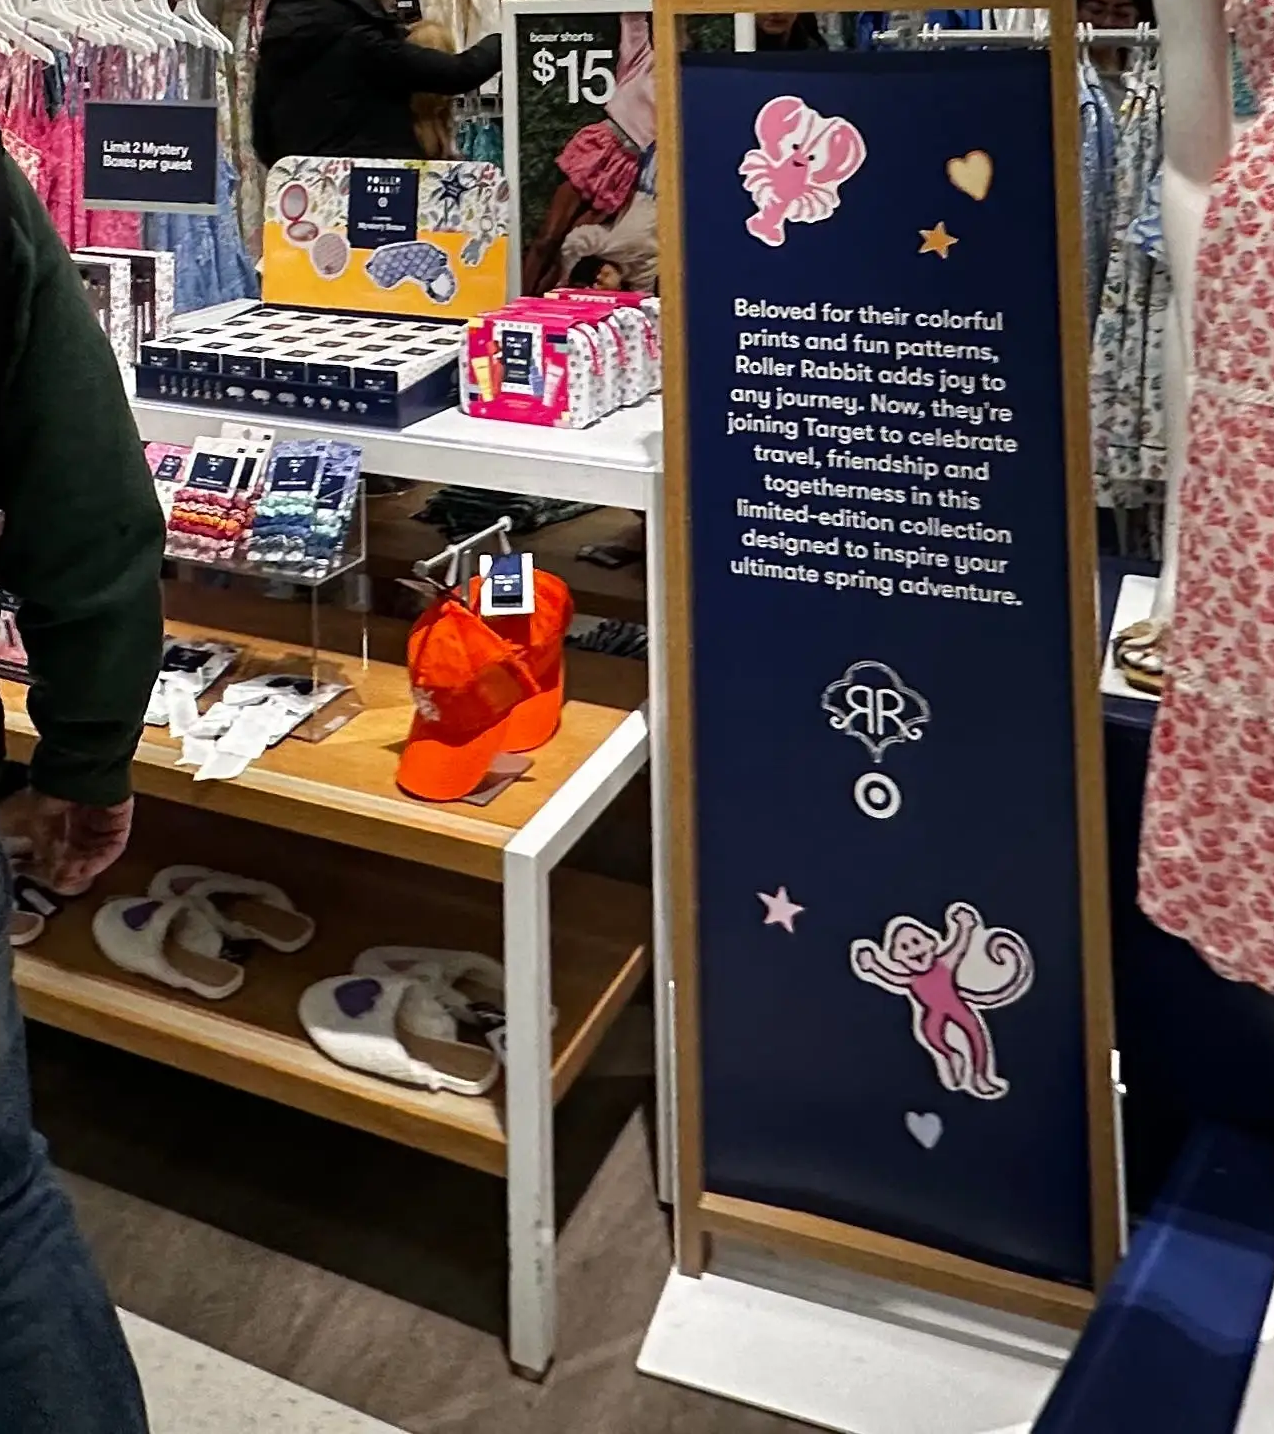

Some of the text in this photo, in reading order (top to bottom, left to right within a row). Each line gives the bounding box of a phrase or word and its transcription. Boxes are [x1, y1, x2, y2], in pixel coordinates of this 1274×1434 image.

[533, 47, 616, 105] $15
[103, 140, 189, 158] Limit 2 Mystery
[103, 154, 192, 172] Boxes per guest
[734, 297, 1004, 331] Beloved for their colorful
[739, 329, 1000, 363] prints and fun patterns,
[735, 355, 1006, 394] Roller Rabbit adds joy to
[730, 387, 1013, 425] any journey. Now, they're
[726, 411, 1018, 453] joining Target to celebrate
[753, 444, 990, 481] travel, friendship and
[763, 474, 981, 511] togetherness in this
[736, 498, 1012, 544] limited-edition collection
[741, 529, 1009, 576] designed to inspire your
[730, 556, 1023, 606] ultimate spring adventure.
